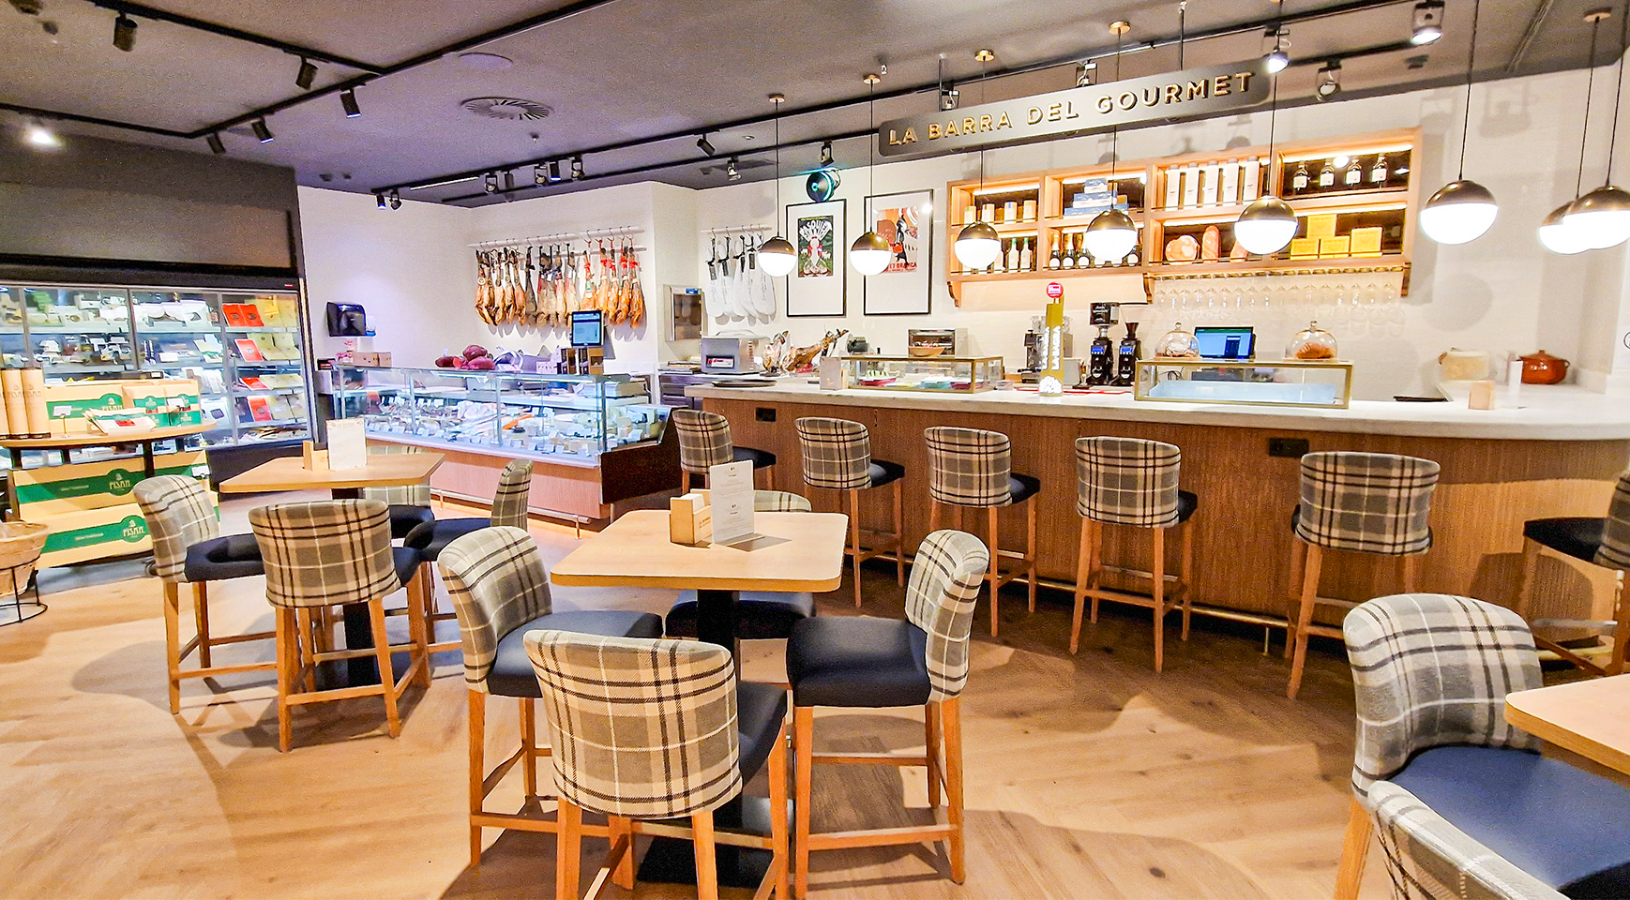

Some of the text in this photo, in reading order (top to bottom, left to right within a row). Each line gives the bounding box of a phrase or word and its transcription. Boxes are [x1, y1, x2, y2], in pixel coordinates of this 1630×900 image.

[888, 72, 1254, 146] LA BARRA DEL GOURMET
